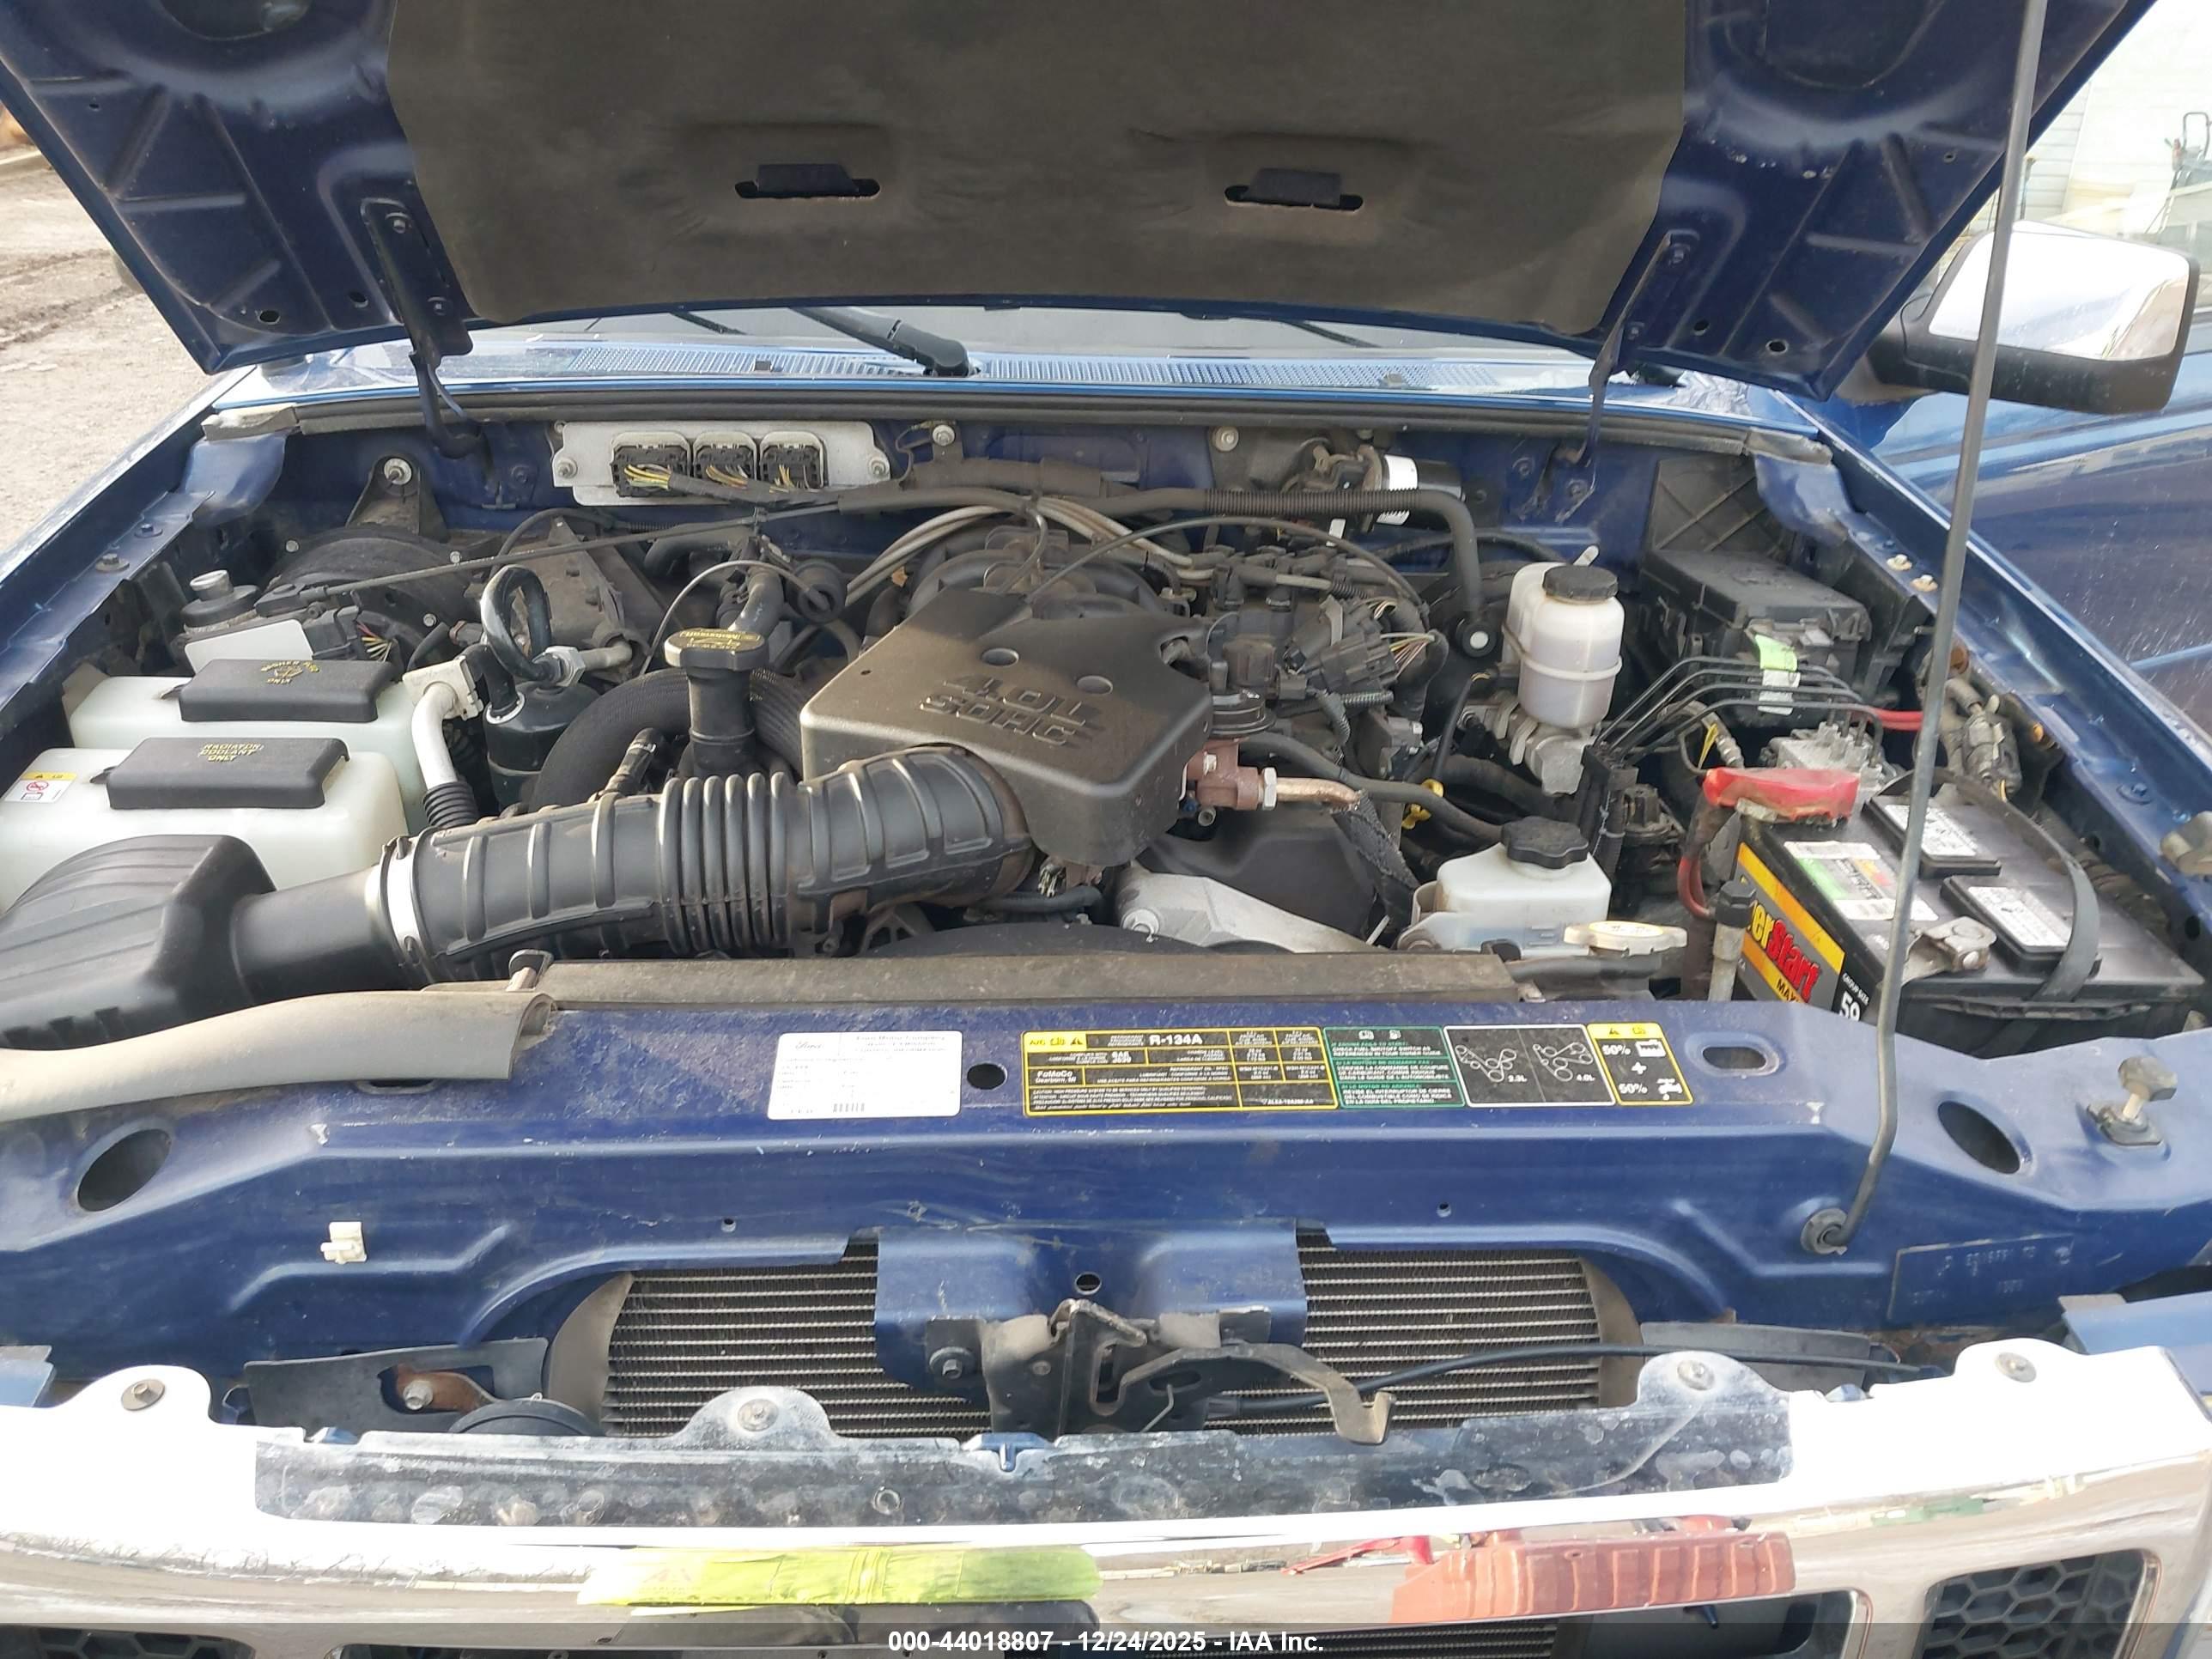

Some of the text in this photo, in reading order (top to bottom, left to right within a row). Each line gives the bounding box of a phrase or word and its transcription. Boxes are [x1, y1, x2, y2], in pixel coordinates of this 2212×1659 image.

[920, 694, 1077, 746] SOHC
[1843, 972, 1859, 994] GROUP
[1149, 1034, 1203, 1046] R-134A
[1601, 1044, 1631, 1055] 50%
[1619, 1083, 1648, 1094] 50%
